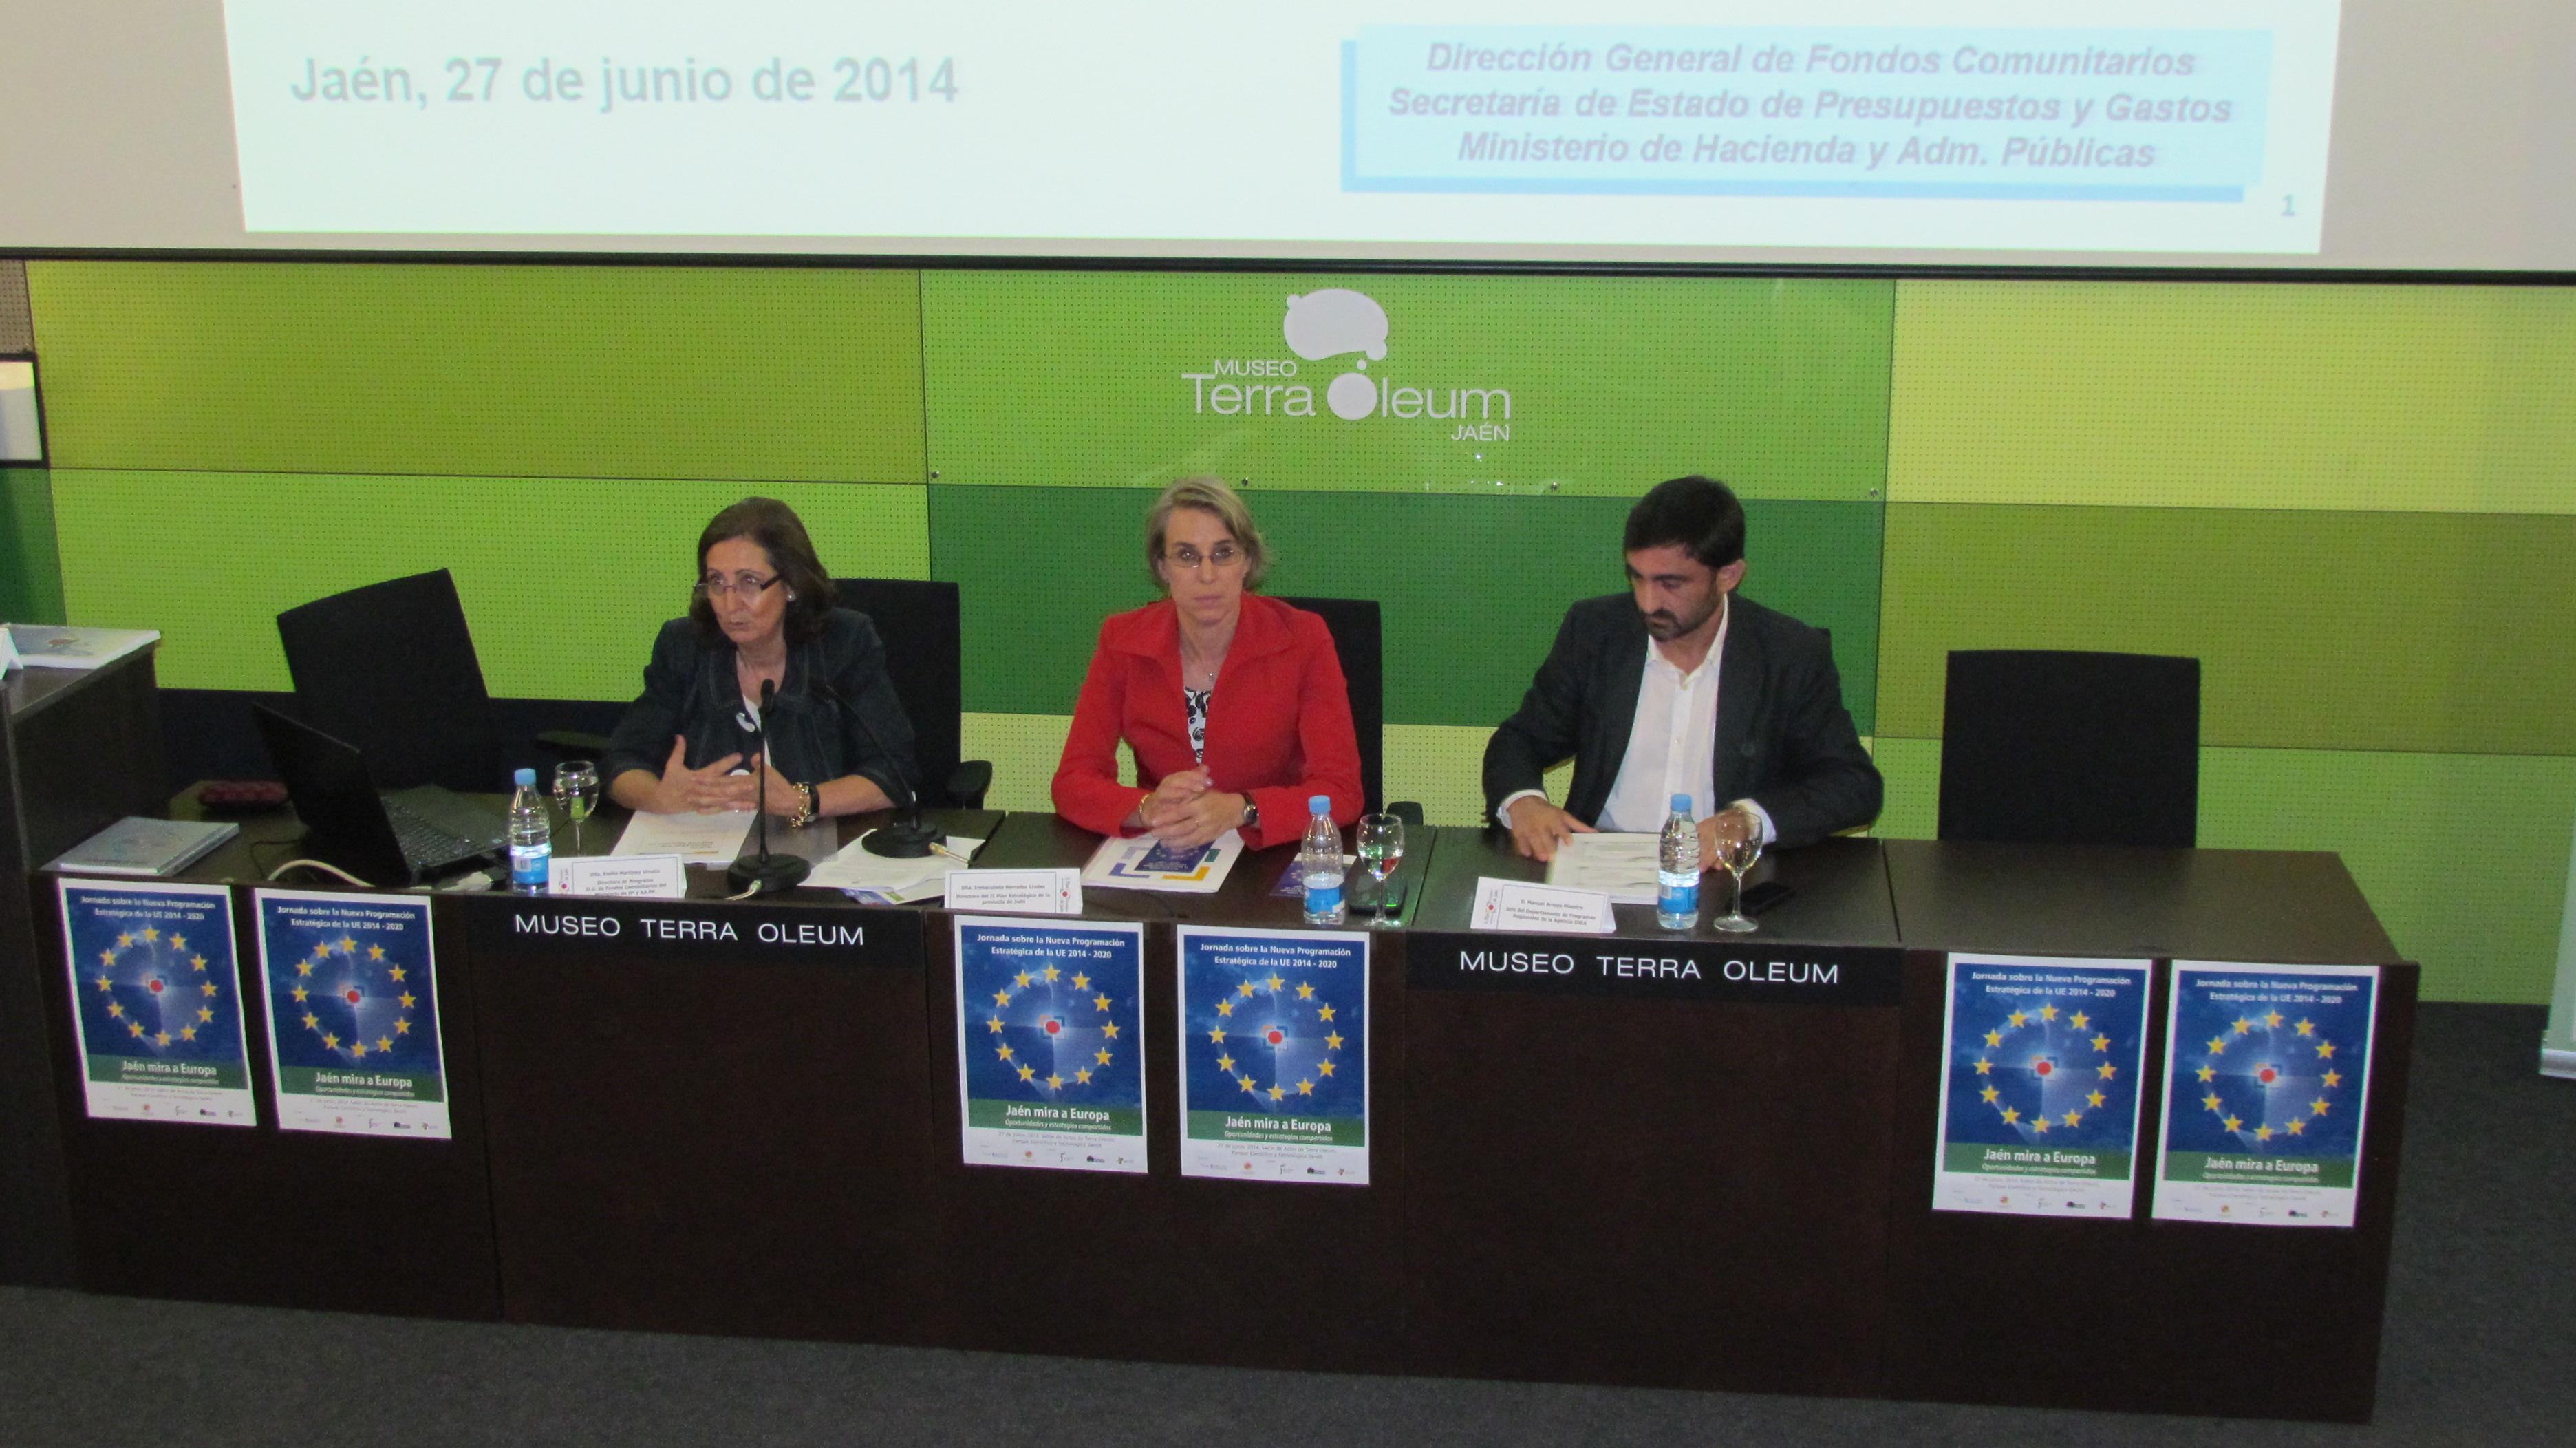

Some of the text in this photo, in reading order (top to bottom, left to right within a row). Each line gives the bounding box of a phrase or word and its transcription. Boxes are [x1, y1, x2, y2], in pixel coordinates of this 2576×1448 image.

[1427, 42, 2196, 76] Dirección General de Fondos Comunitarios
[290, 54, 958, 114] Jaén, 27 de junio de 2014
[1389, 87, 2232, 127] Secretaría de Estado de Presupuestos y Gastos
[1459, 131, 2156, 171] Ministerio de Hacienda y Adm. Públicas
[2282, 193, 2297, 217] 1
[1214, 359, 1297, 377] MUSEO
[1181, 373, 1316, 416] Terra
[1451, 421, 1510, 441] JAÉN
[277, 906, 308, 915] Jornada
[309, 907, 330, 915] sobre
[365, 910, 414, 921] Programación
[515, 914, 863, 946] MUSEO TERRA OLEUM
[977, 934, 1009, 942] Jornada
[1072, 937, 1125, 948] Programación
[991, 946, 1033, 957] Estratégica
[1200, 944, 1233, 952] Jornada
[1236, 944, 1258, 952] sobre
[1297, 947, 1351, 958] Programación
[1214, 956, 1256, 967] Estratégica
[1461, 951, 1838, 984] MUSEO TERRA OLEUM
[1972, 972, 2007, 981] Jornada
[2009, 973, 2033, 981] sobre
[2046, 975, 2072, 983] Nueva
[2074, 975, 2131, 986] Programación
[1986, 985, 2030, 996] Estratégica
[2033, 986, 2043, 994] de
[121, 1059, 216, 1078] Jaén mira a Europa
[314, 1072, 412, 1089] Jaén mira a Europa
[1005, 1104, 1109, 1123] Jaén mira a Europa
[1225, 1116, 1331, 1134] Jaén mira a Europa
[1984, 1148, 2096, 1167] Jaén mira a Europa
[2205, 1156, 2319, 1175] Jaén mira a Europa
